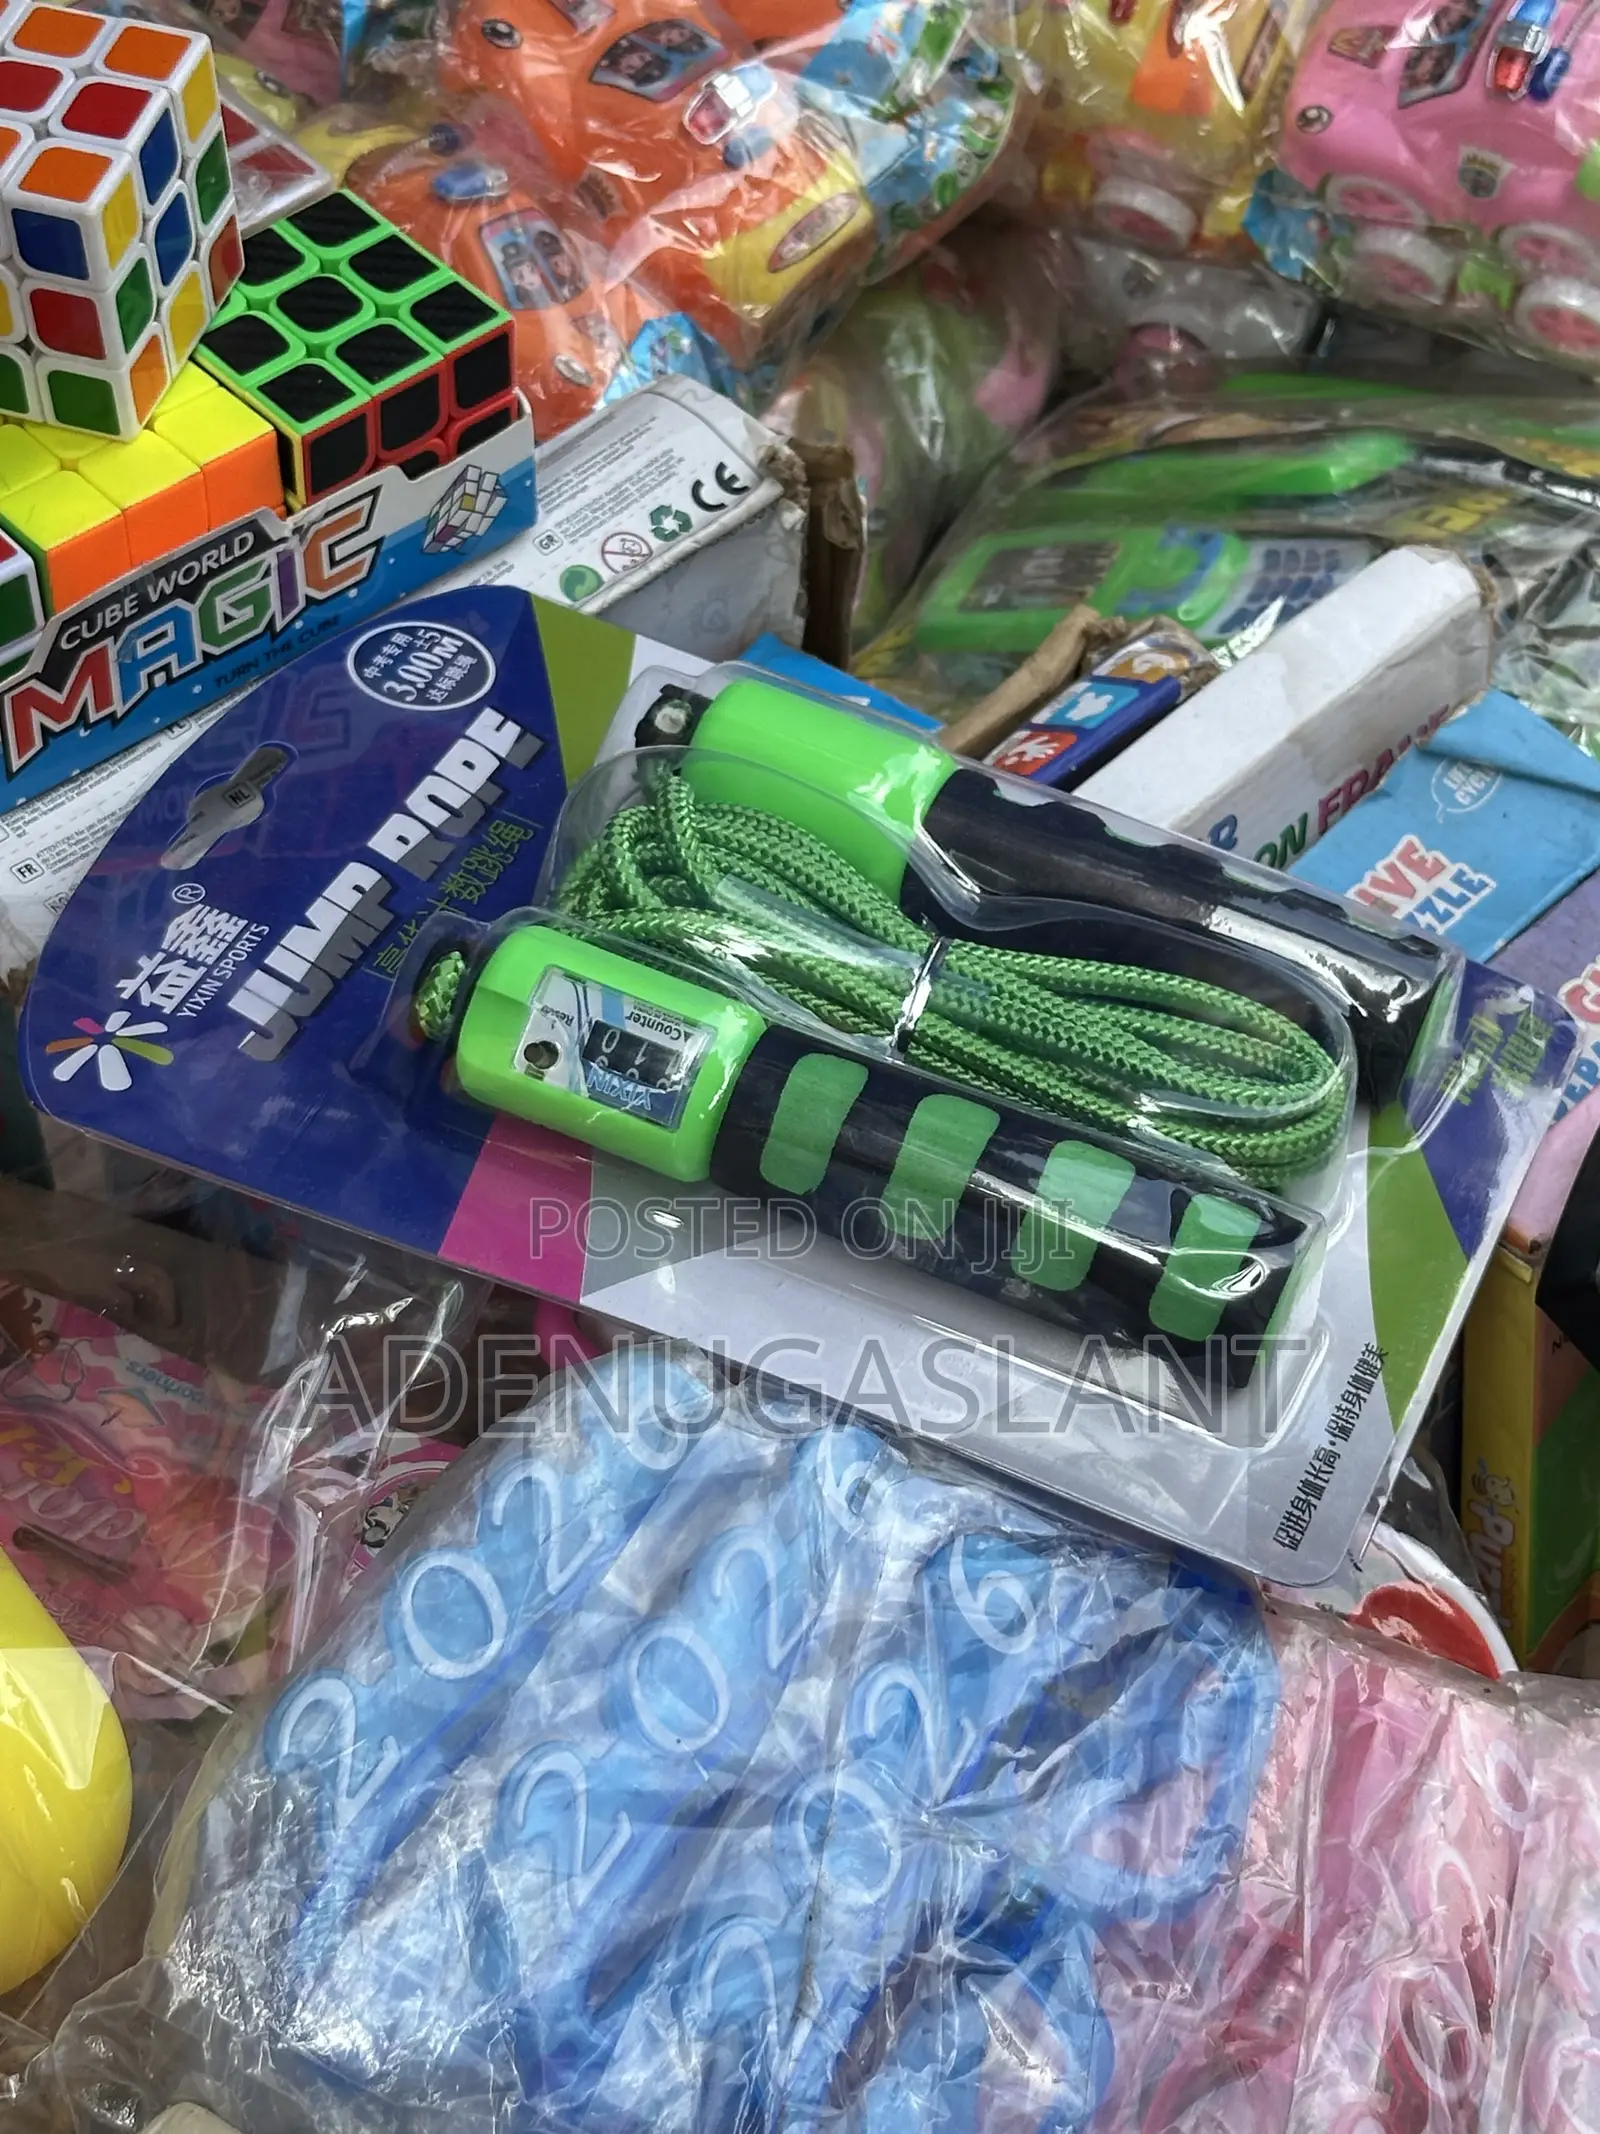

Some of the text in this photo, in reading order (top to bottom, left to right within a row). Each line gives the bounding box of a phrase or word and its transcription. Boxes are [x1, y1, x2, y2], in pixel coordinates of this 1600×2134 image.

[4, 485, 383, 775] MAGIC
[60, 530, 256, 651] CUBE WORLD
[17, 863, 37, 879] FR
[227, 706, 546, 1062] JUMP ROPE
[116, 903, 248, 1016] 益鑫
[176, 922, 270, 1018] YIXIN SPORTS
[624, 1009, 682, 1042] Counter
